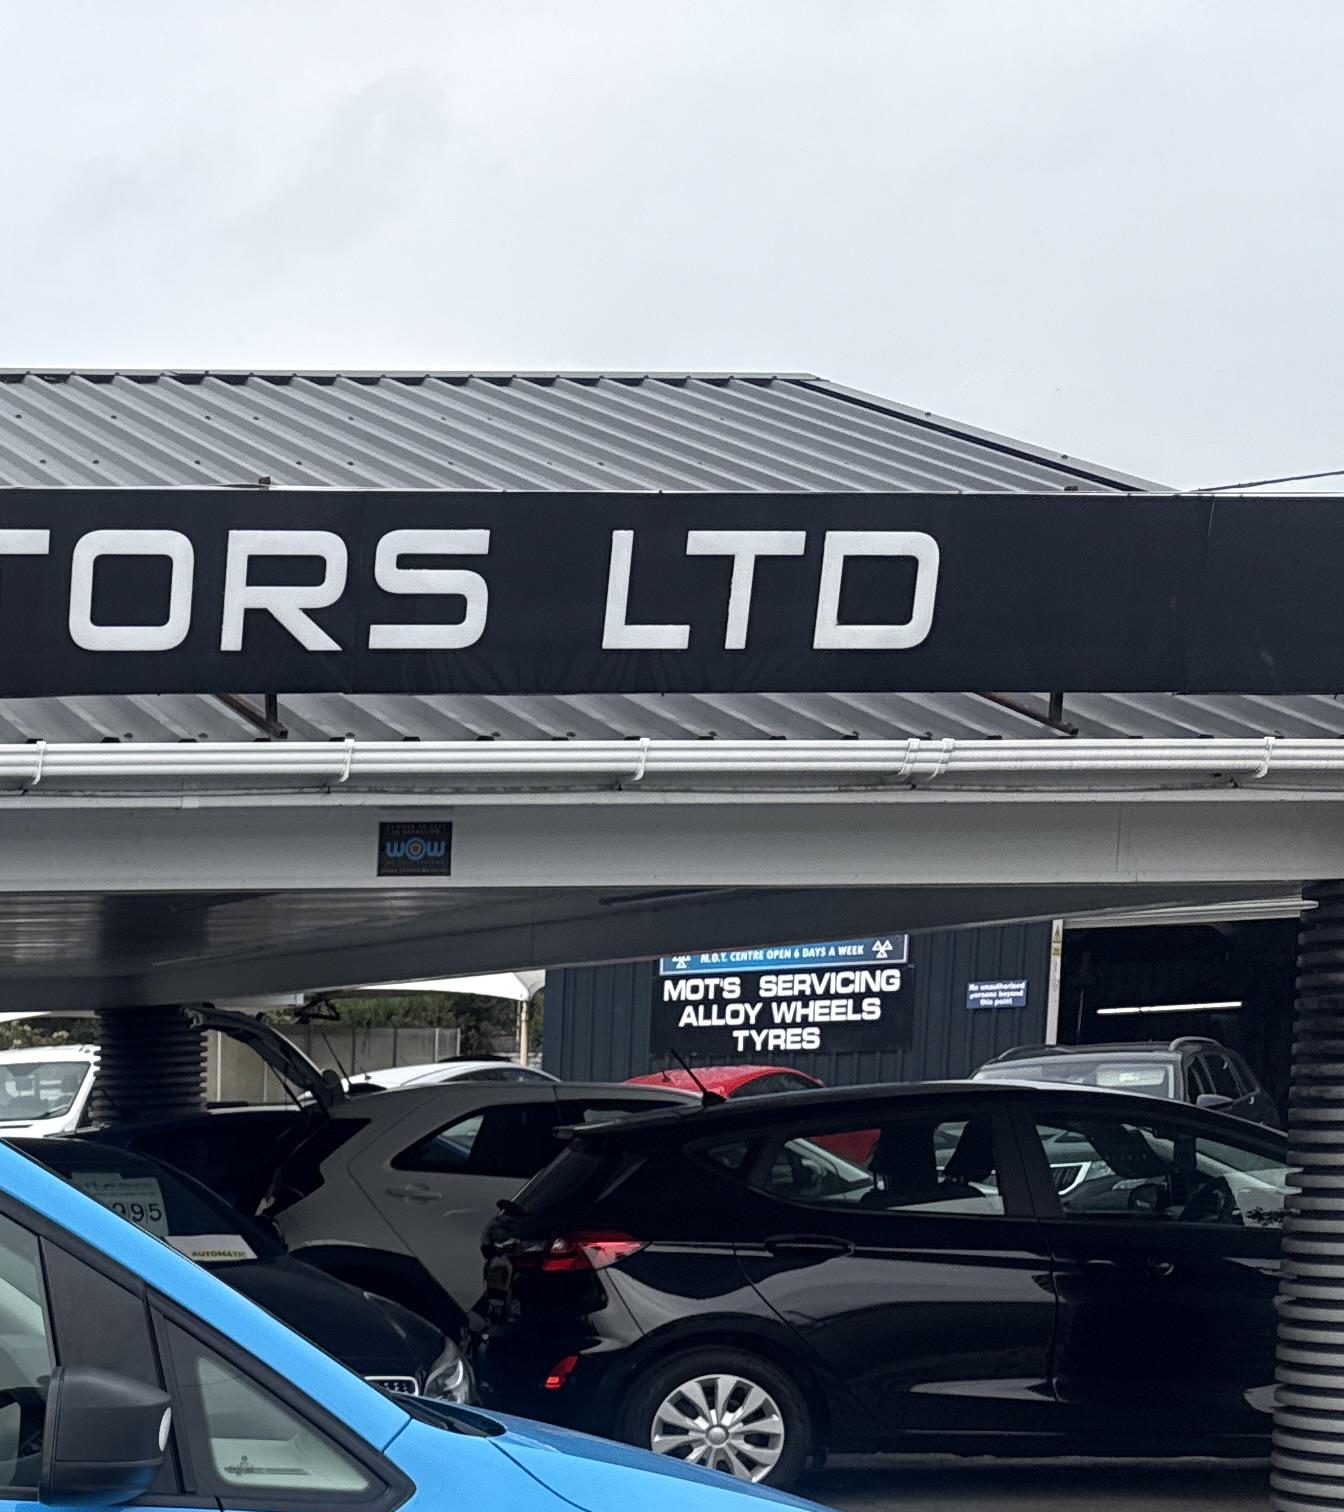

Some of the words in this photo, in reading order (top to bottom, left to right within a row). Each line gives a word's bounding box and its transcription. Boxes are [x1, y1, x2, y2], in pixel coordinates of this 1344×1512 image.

[600, 529, 941, 651] LTD
[730, 951, 764, 962] CENTRE
[766, 949, 792, 960] OPEN
[794, 947, 800, 959] 6
[802, 946, 826, 958] DAYS
[828, 946, 836, 957] A
[838, 944, 864, 956] WEEK
[663, 976, 741, 1001] MOT'S
[759, 969, 901, 998] SERVICING
[678, 1002, 763, 1027] ALLOY
[771, 997, 881, 1024] WHEELS
[732, 1027, 821, 1051] TYRES
